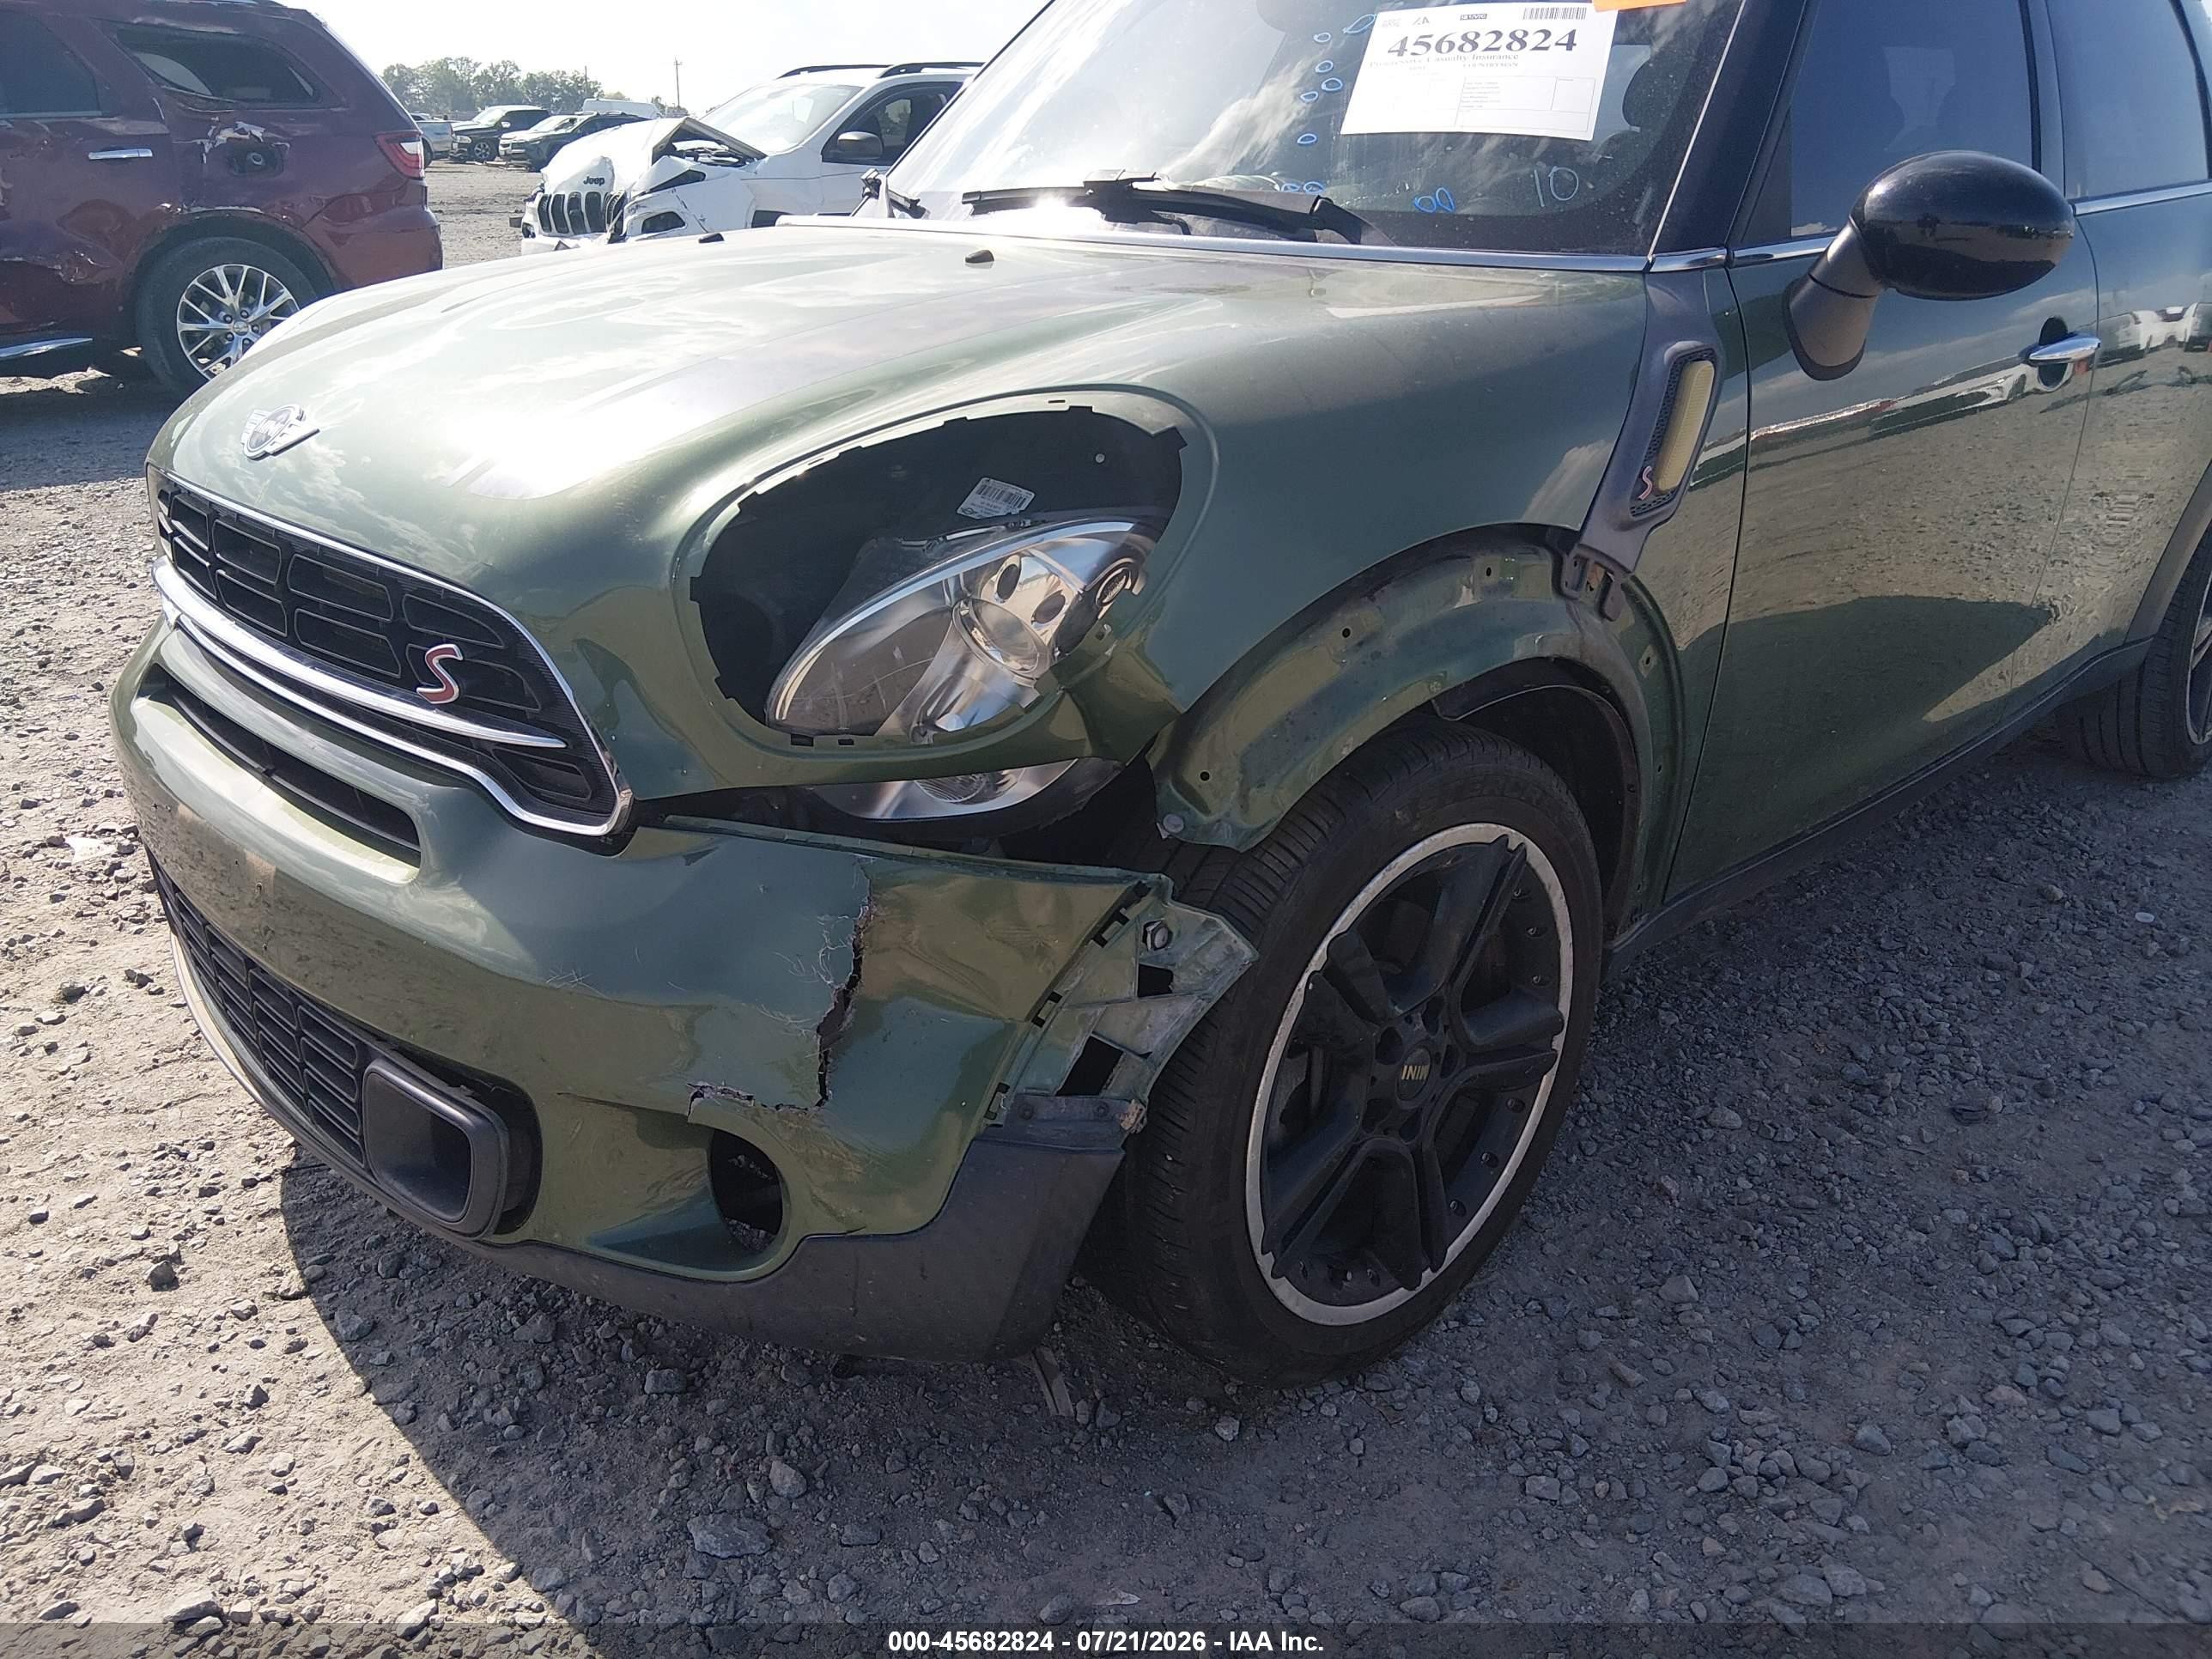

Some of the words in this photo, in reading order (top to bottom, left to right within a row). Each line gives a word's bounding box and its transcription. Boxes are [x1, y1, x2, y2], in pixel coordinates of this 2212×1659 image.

[1387, 28, 1577, 58] 45682824
[583, 175, 605, 187] Jeep
[416, 643, 464, 704] S
[1401, 1064, 1430, 1080] MINI
